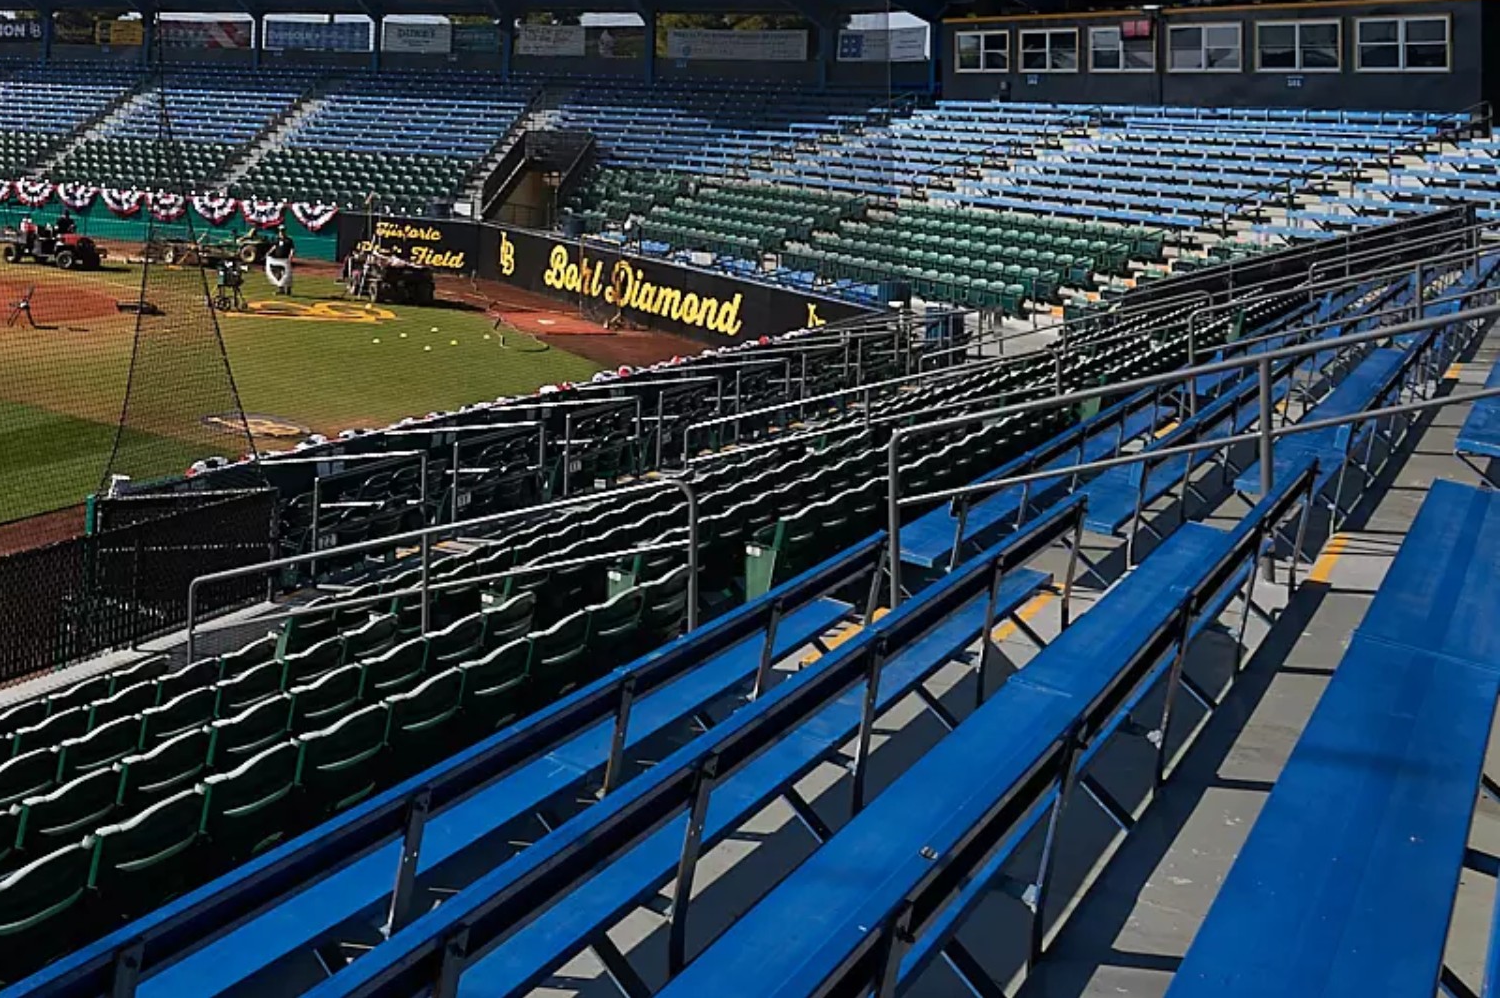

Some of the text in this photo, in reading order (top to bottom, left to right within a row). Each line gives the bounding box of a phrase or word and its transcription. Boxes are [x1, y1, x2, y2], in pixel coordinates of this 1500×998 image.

[375, 221, 442, 241] Historic
[410, 246, 465, 269] Field
[544, 245, 744, 337] Bohl Diamond
